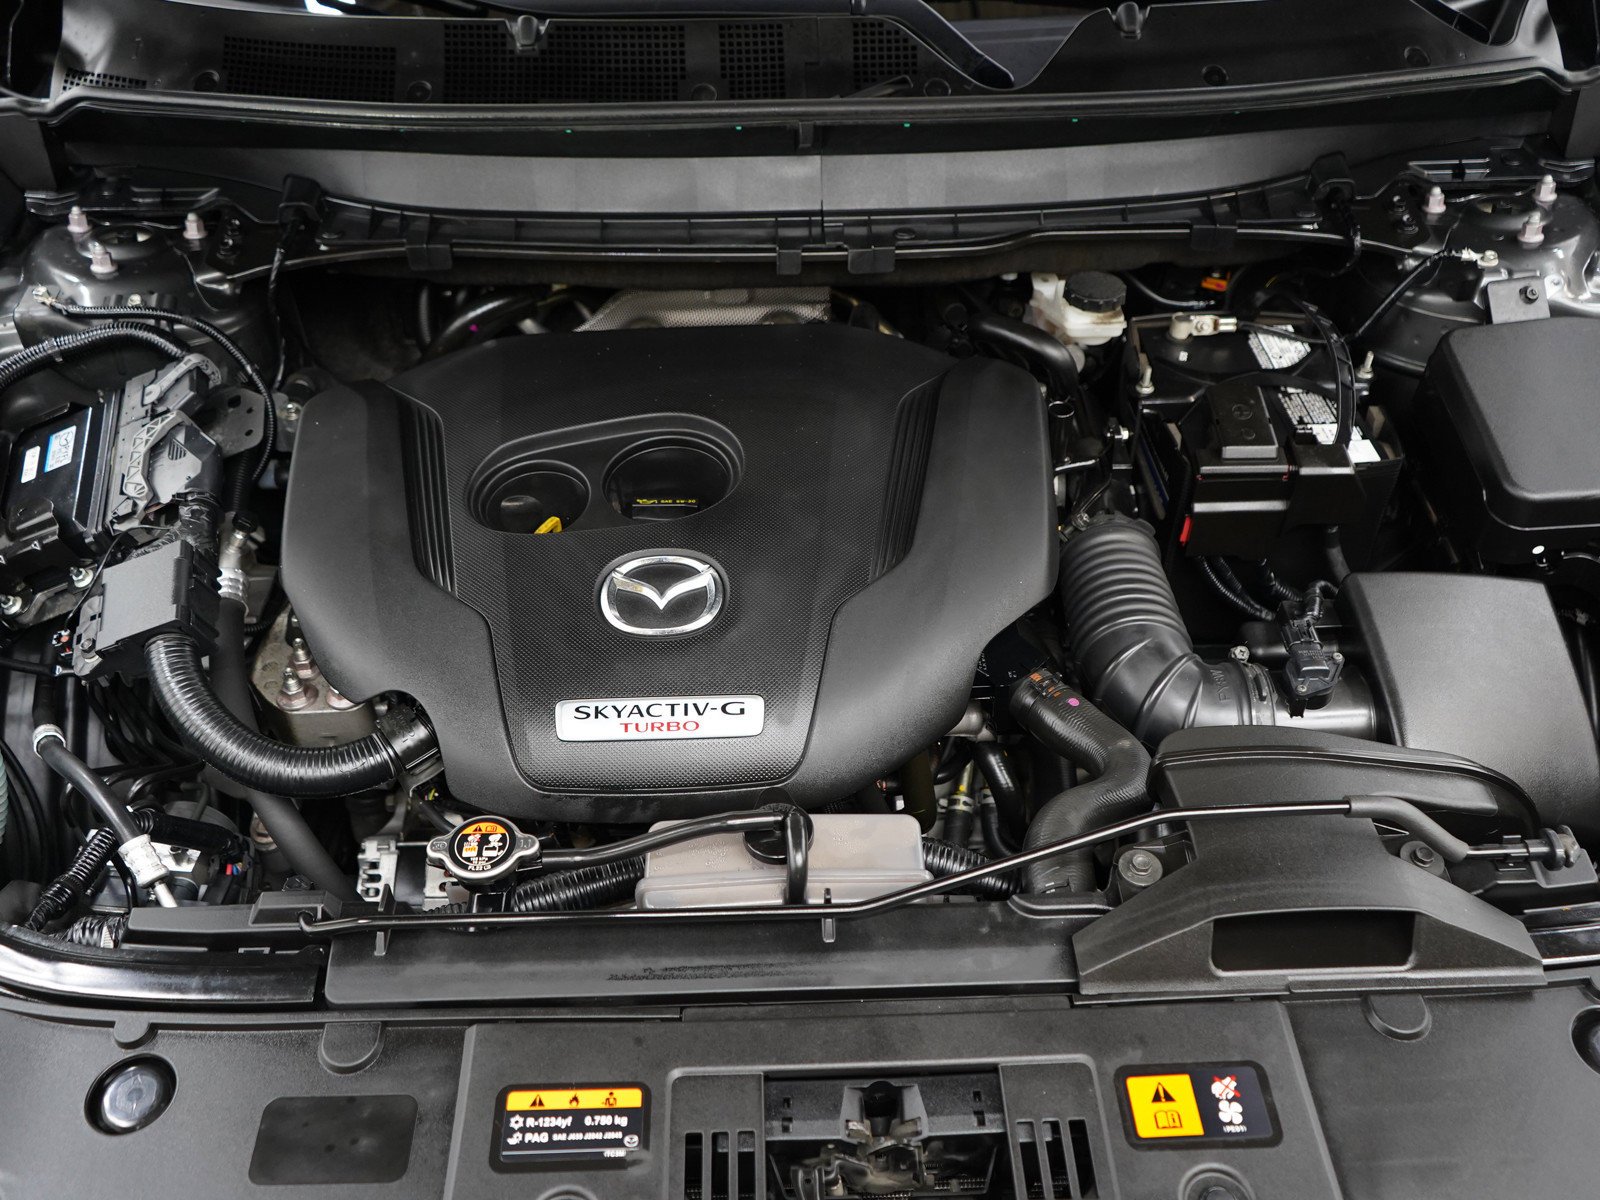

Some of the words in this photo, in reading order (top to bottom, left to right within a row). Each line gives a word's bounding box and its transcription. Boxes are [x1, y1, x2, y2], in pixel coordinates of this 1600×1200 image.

[573, 701, 745, 720] SKYACTIV-G
[619, 720, 700, 733] TURBO
[525, 1115, 573, 1129] R-1234yf
[583, 1114, 613, 1127] 0.750
[613, 1114, 629, 1127] kg
[524, 1131, 549, 1144] PAG
